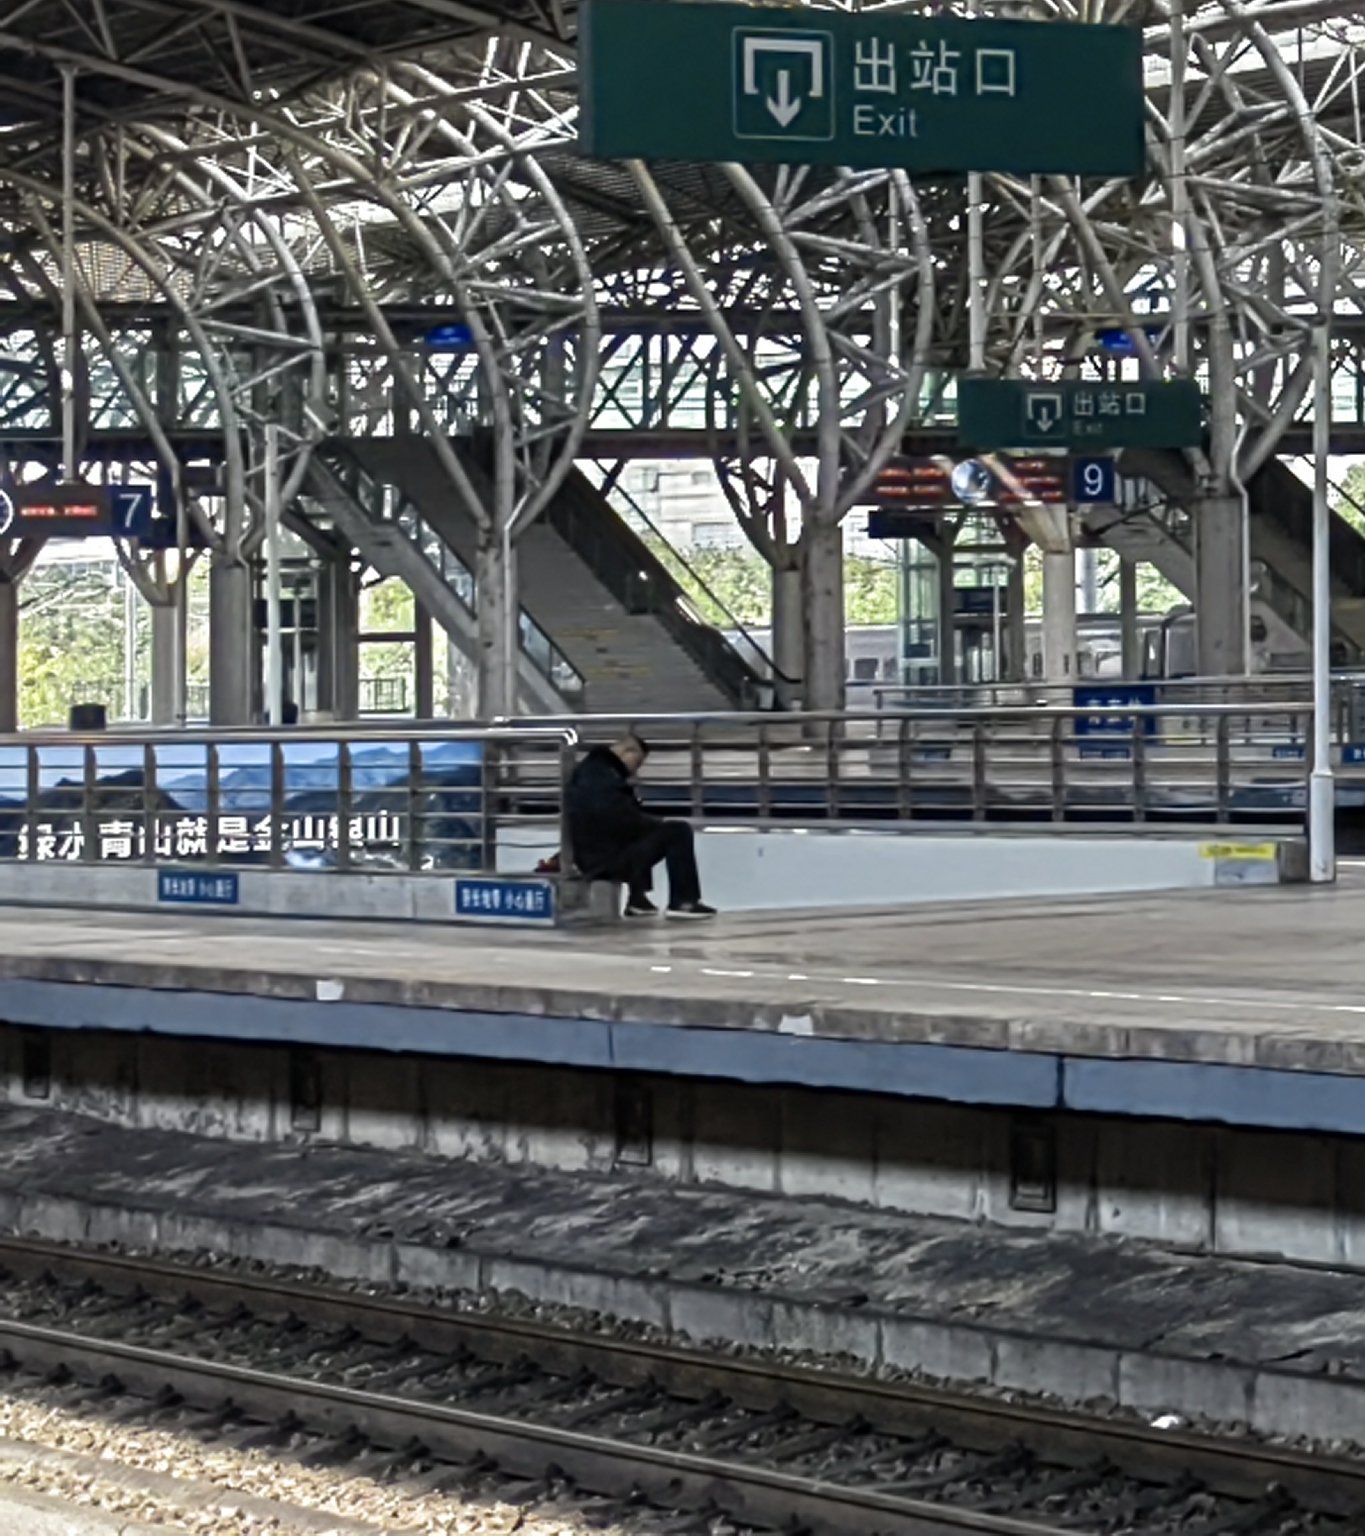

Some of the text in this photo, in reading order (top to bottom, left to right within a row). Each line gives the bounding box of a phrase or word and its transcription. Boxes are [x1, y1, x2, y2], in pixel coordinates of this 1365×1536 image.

[853, 36, 1017, 98] 出站口
[852, 104, 918, 139] Exit
[1074, 391, 1146, 416] 出站口
[1083, 462, 1104, 496] 9
[118, 492, 143, 528] 7
